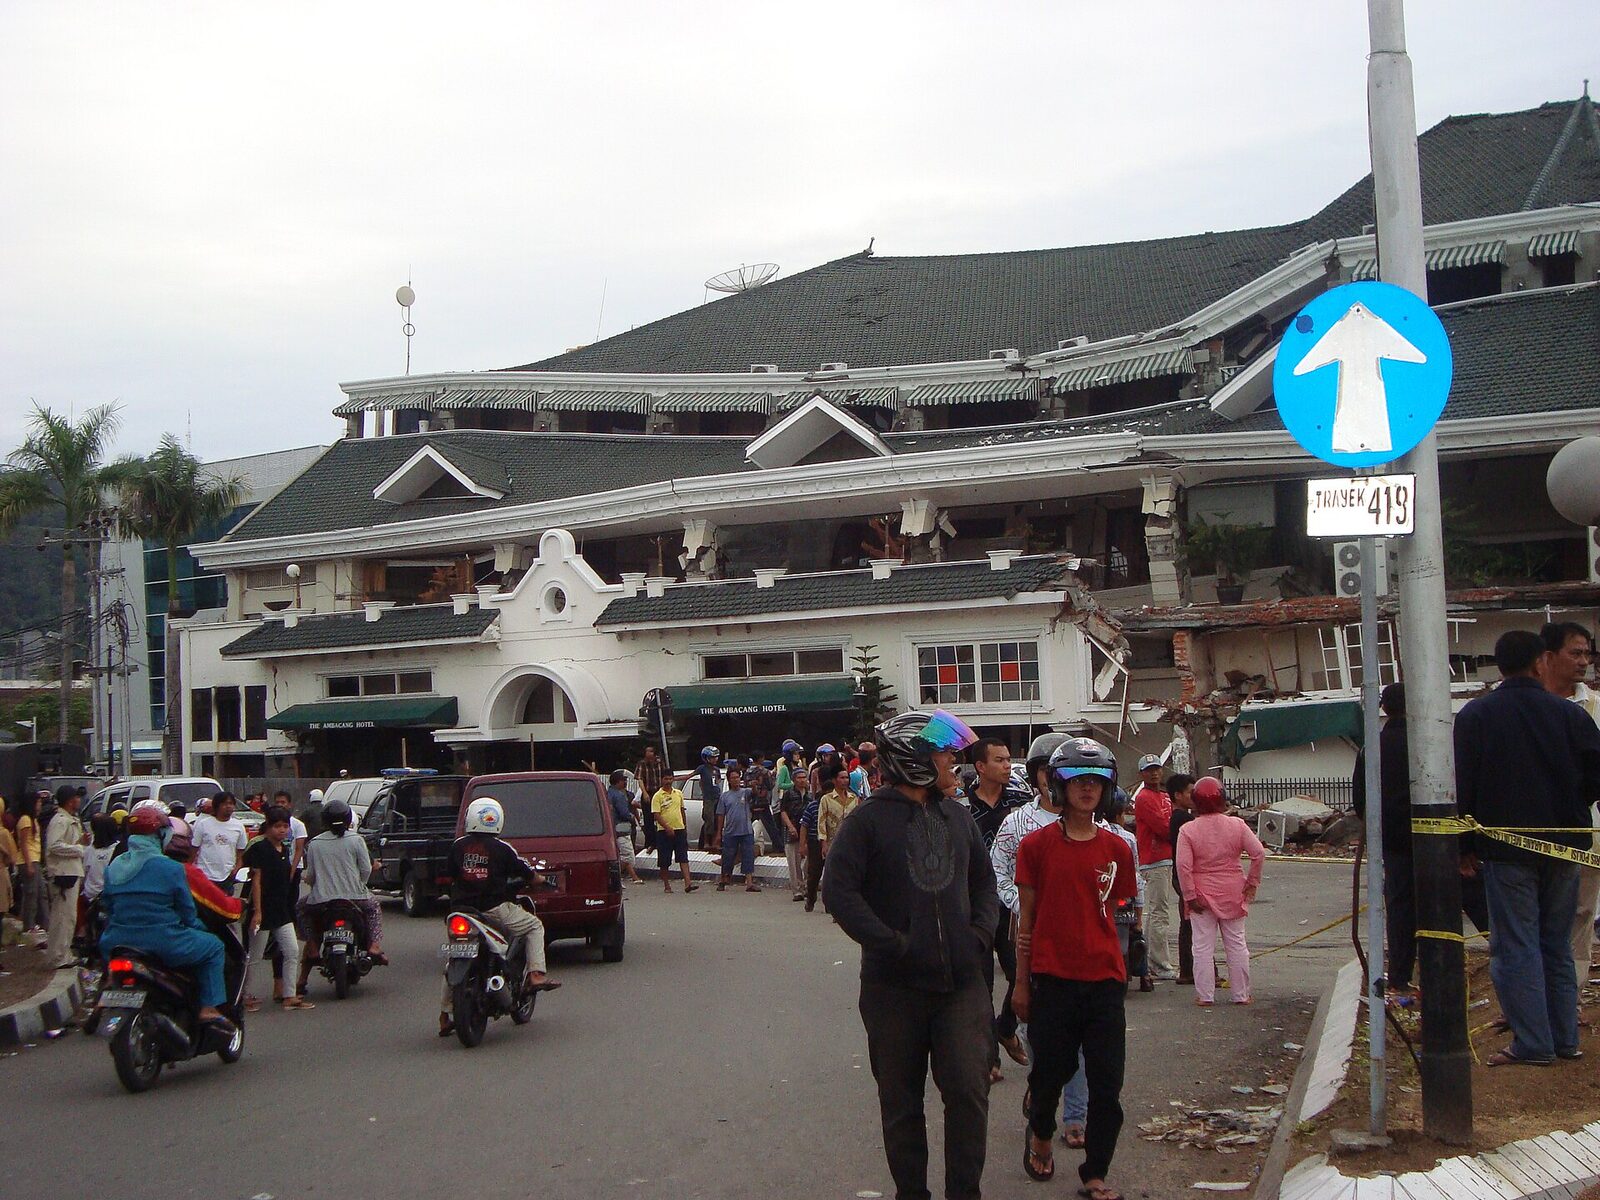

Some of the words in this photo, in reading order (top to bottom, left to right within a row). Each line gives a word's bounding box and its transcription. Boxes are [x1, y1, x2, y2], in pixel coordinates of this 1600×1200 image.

[1315, 487, 1365, 508] TRAYEK
[1367, 485, 1408, 525] 419
[700, 707, 714, 715] THE
[718, 706, 759, 714] AMBACANG
[762, 704, 787, 712] HOTEL
